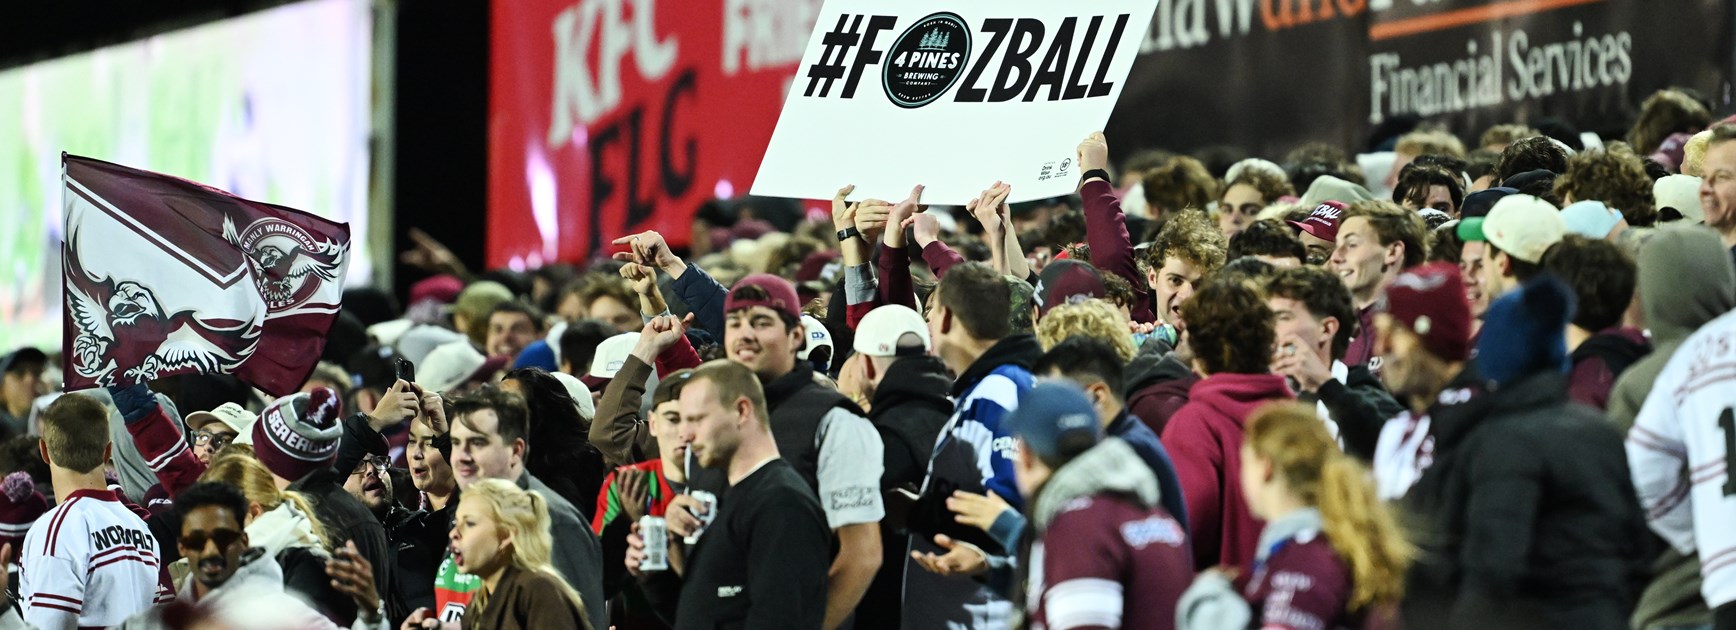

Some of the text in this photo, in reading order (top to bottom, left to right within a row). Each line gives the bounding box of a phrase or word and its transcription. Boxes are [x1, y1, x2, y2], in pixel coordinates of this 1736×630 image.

[894, 51, 960, 69] 4 PINES
[903, 72, 939, 80] BREWING
[1369, 20, 1632, 124] Financial Services
[243, 224, 315, 251] MANLY WARRINGAH
